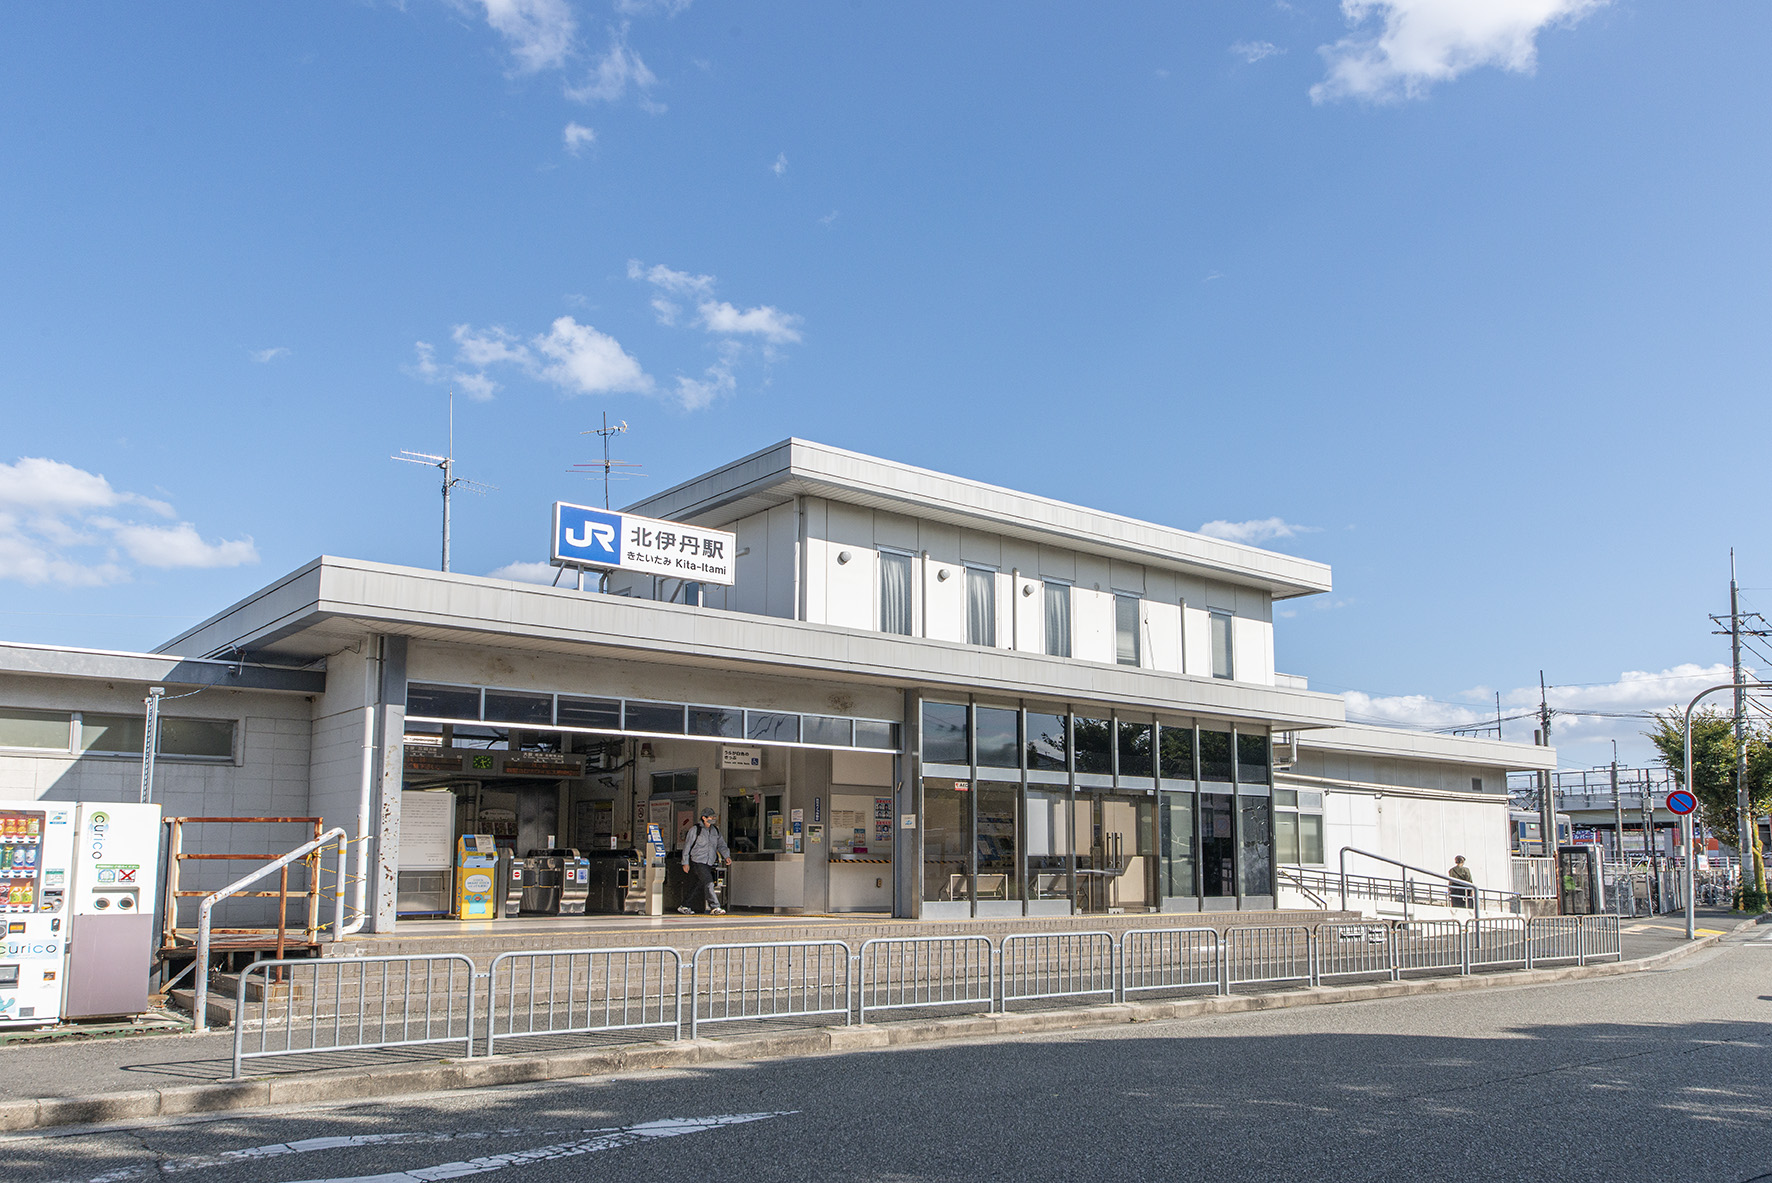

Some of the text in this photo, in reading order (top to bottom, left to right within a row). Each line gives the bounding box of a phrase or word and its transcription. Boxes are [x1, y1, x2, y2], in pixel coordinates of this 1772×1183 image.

[565, 520, 615, 553] JR
[631, 526, 724, 560] 北伊丹駅
[627, 551, 727, 575] きたいたみ Kita-Itami
[92, 814, 106, 860] curico
